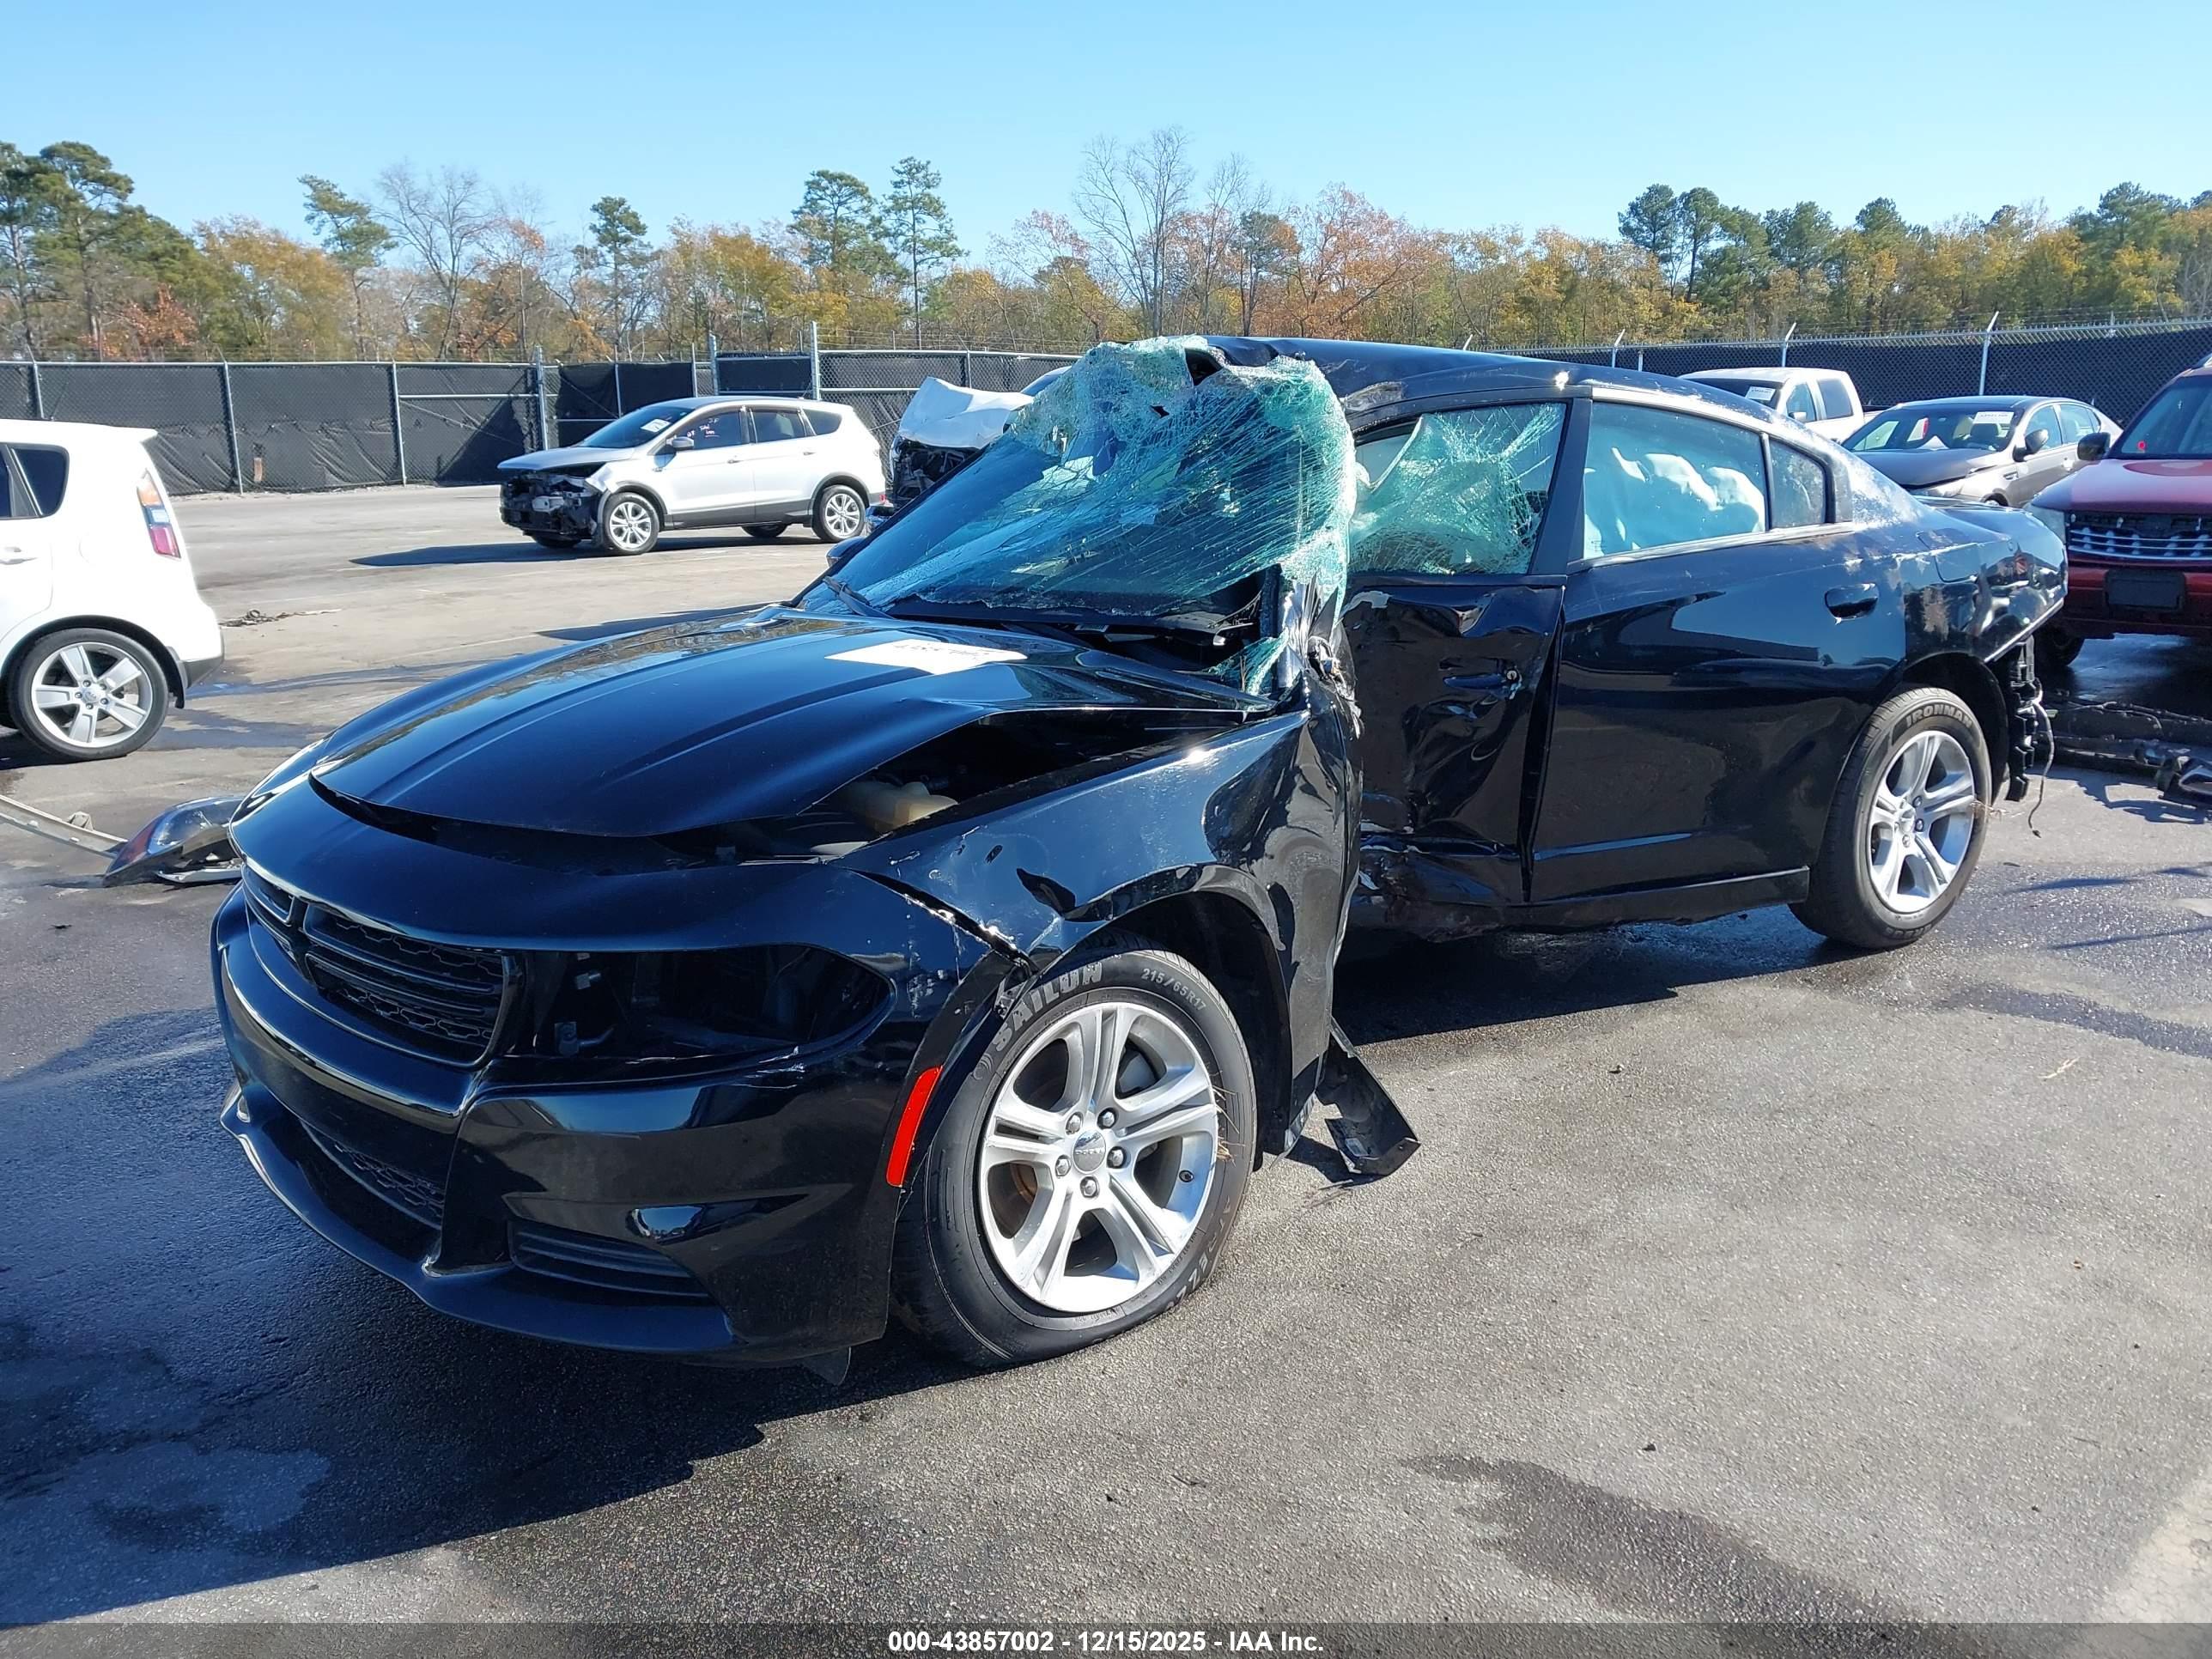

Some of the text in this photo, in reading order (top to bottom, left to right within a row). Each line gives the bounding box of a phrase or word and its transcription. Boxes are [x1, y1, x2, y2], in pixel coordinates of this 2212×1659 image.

[1905, 703, 1972, 727] IRONMAN
[992, 961, 1103, 1052] SAILUN
[1140, 968, 1206, 1011] 215/65R17
